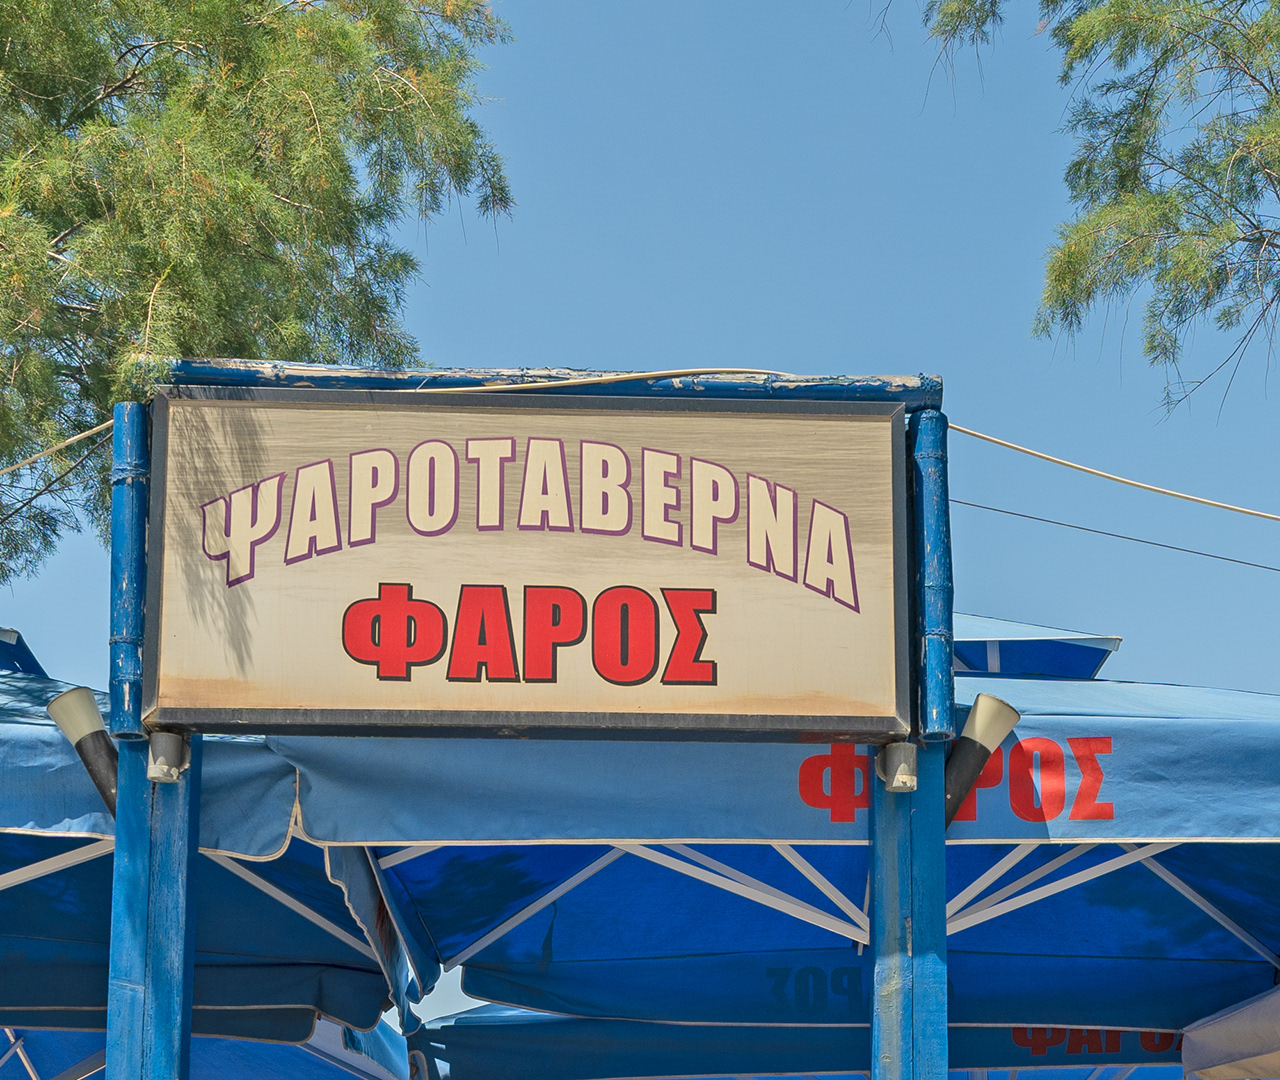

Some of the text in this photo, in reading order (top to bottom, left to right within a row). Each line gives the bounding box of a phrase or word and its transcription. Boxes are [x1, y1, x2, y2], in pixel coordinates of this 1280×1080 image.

[200, 436, 860, 613] ΨΑΡΟΤΑΒΕΡΝΑ
[342, 582, 717, 686] ΦΑΡΟΣ
[798, 737, 1114, 823] ΦΡΟΣ
